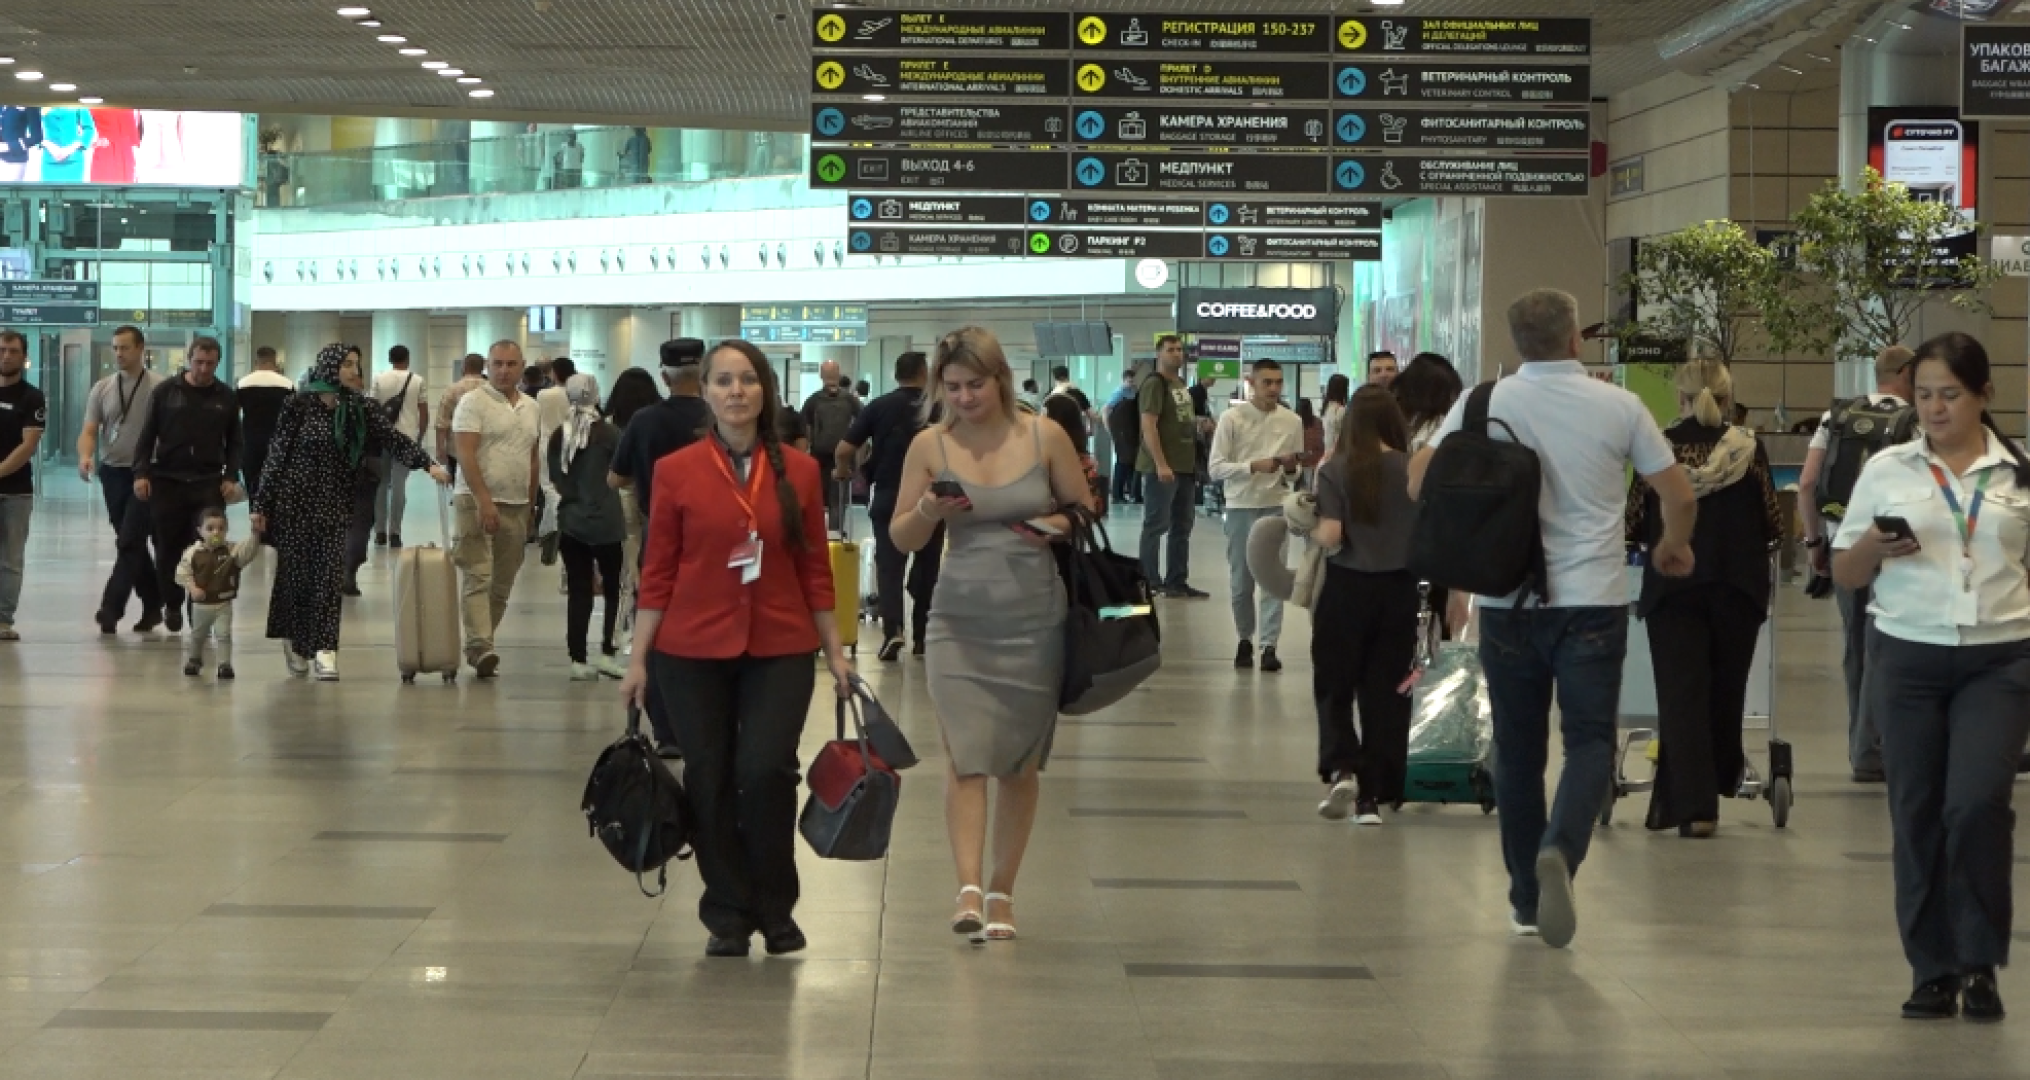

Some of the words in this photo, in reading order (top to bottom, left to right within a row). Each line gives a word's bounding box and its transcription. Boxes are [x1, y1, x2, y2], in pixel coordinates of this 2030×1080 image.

[1162, 21, 1256, 34] РЕГИСТРАЦИЯ
[1262, 22, 1316, 36] 150-237
[1970, 43, 2030, 56] УПАКОВ
[1980, 60, 2030, 72] БАГАЖ
[1421, 70, 1508, 82] ВЕТЕРИНАРНЫЙ
[1512, 72, 1572, 83] КОНТРОЛЬ
[900, 108, 1000, 118] ПРЕДСТАВИТЕЛЬСТВА
[1160, 116, 1214, 128] КАМЕРА
[1217, 116, 1288, 128] ХРАНЕНИЯ
[1421, 117, 1525, 129] ФИТОСАНИТАРНЫЙ
[1528, 119, 1586, 130] КОНТРОЛЬ
[901, 159, 950, 172] ВЫХОД
[953, 160, 975, 172] 4-6
[1160, 162, 1234, 176] МЕДПУНКТ
[909, 202, 960, 211] МЕДПУНКТ
[909, 234, 946, 244] КАМЕРА
[1197, 302, 1317, 319] COFFEE&FOOD
